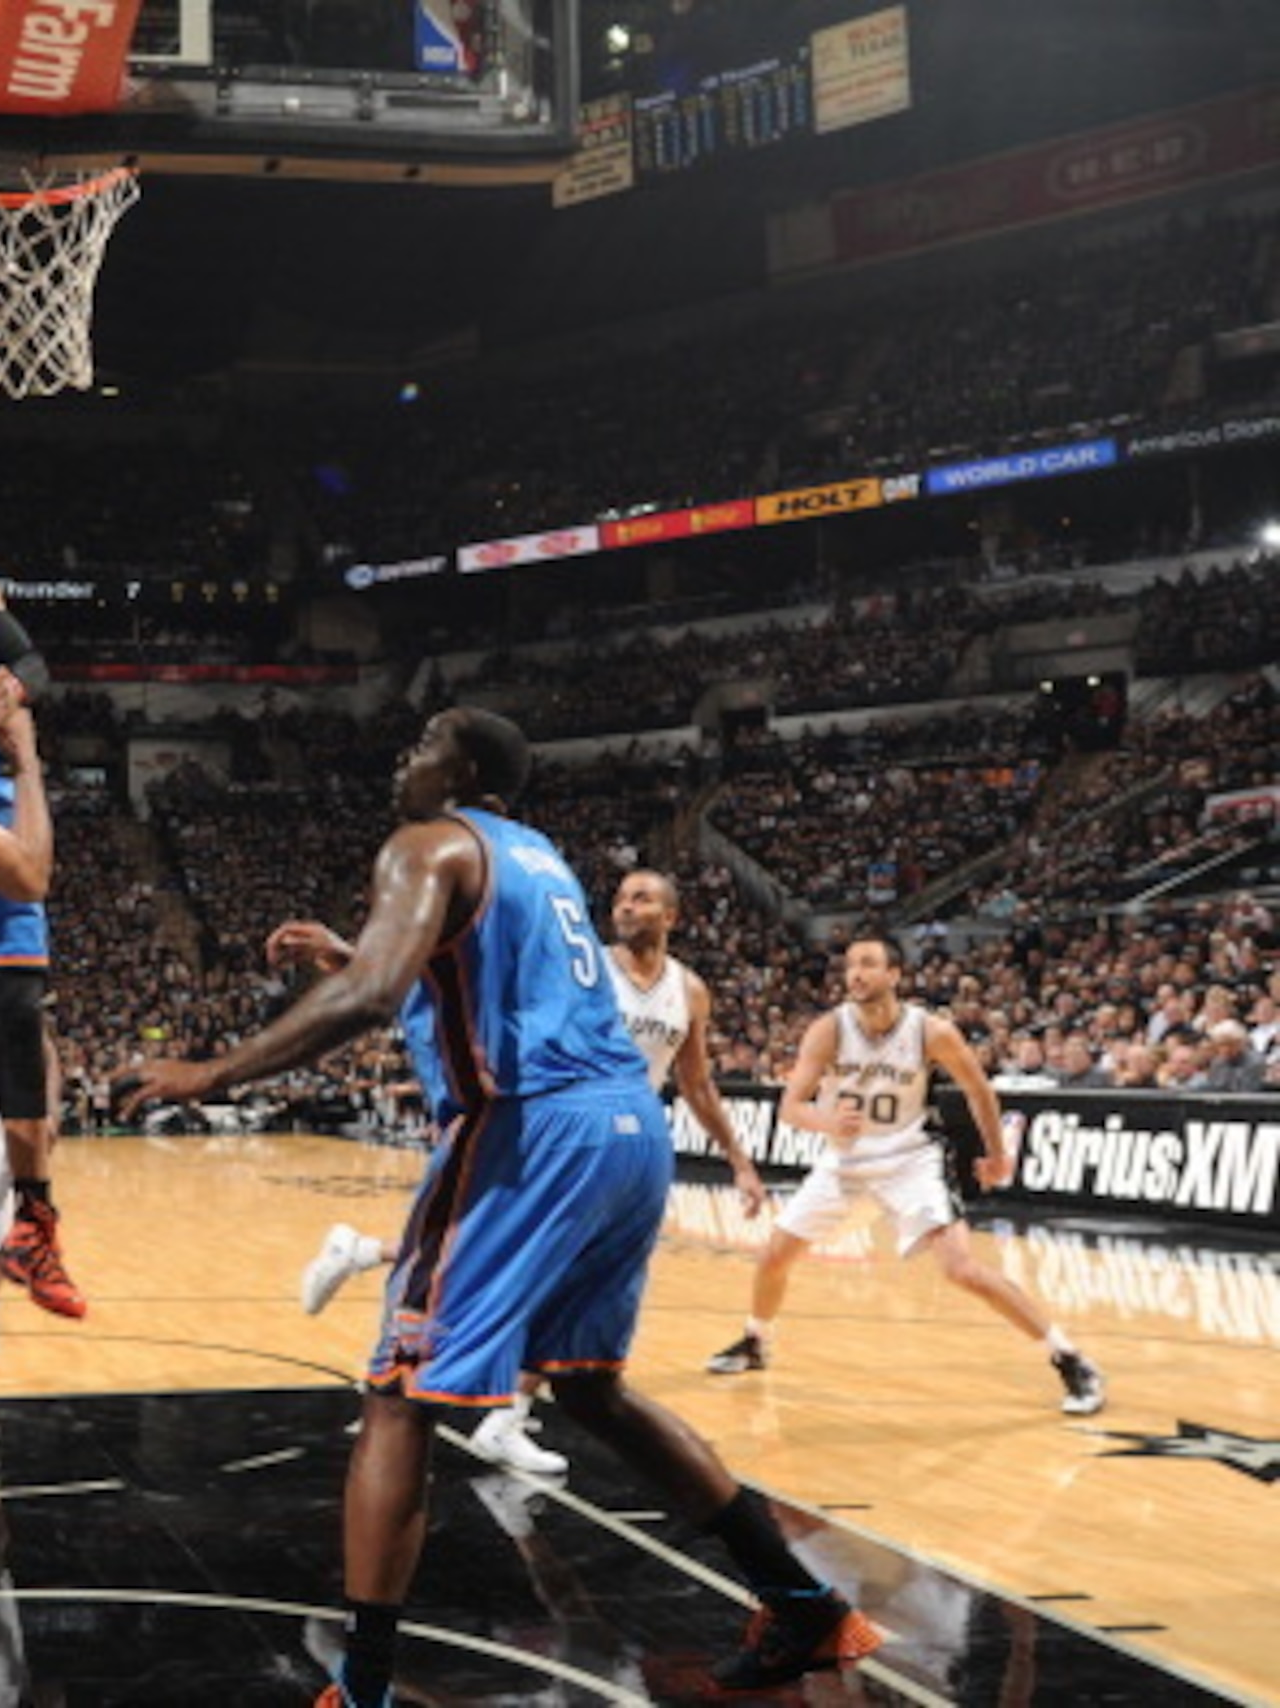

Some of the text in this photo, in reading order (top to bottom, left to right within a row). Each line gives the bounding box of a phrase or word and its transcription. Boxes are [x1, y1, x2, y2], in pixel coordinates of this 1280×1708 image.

[6, 0, 117, 100] Farm
[776, 482, 869, 515] HOLT
[944, 445, 1099, 488] WORLD CAR
[546, 891, 599, 989] 5
[1022, 1108, 1280, 1215] SiriusXM
